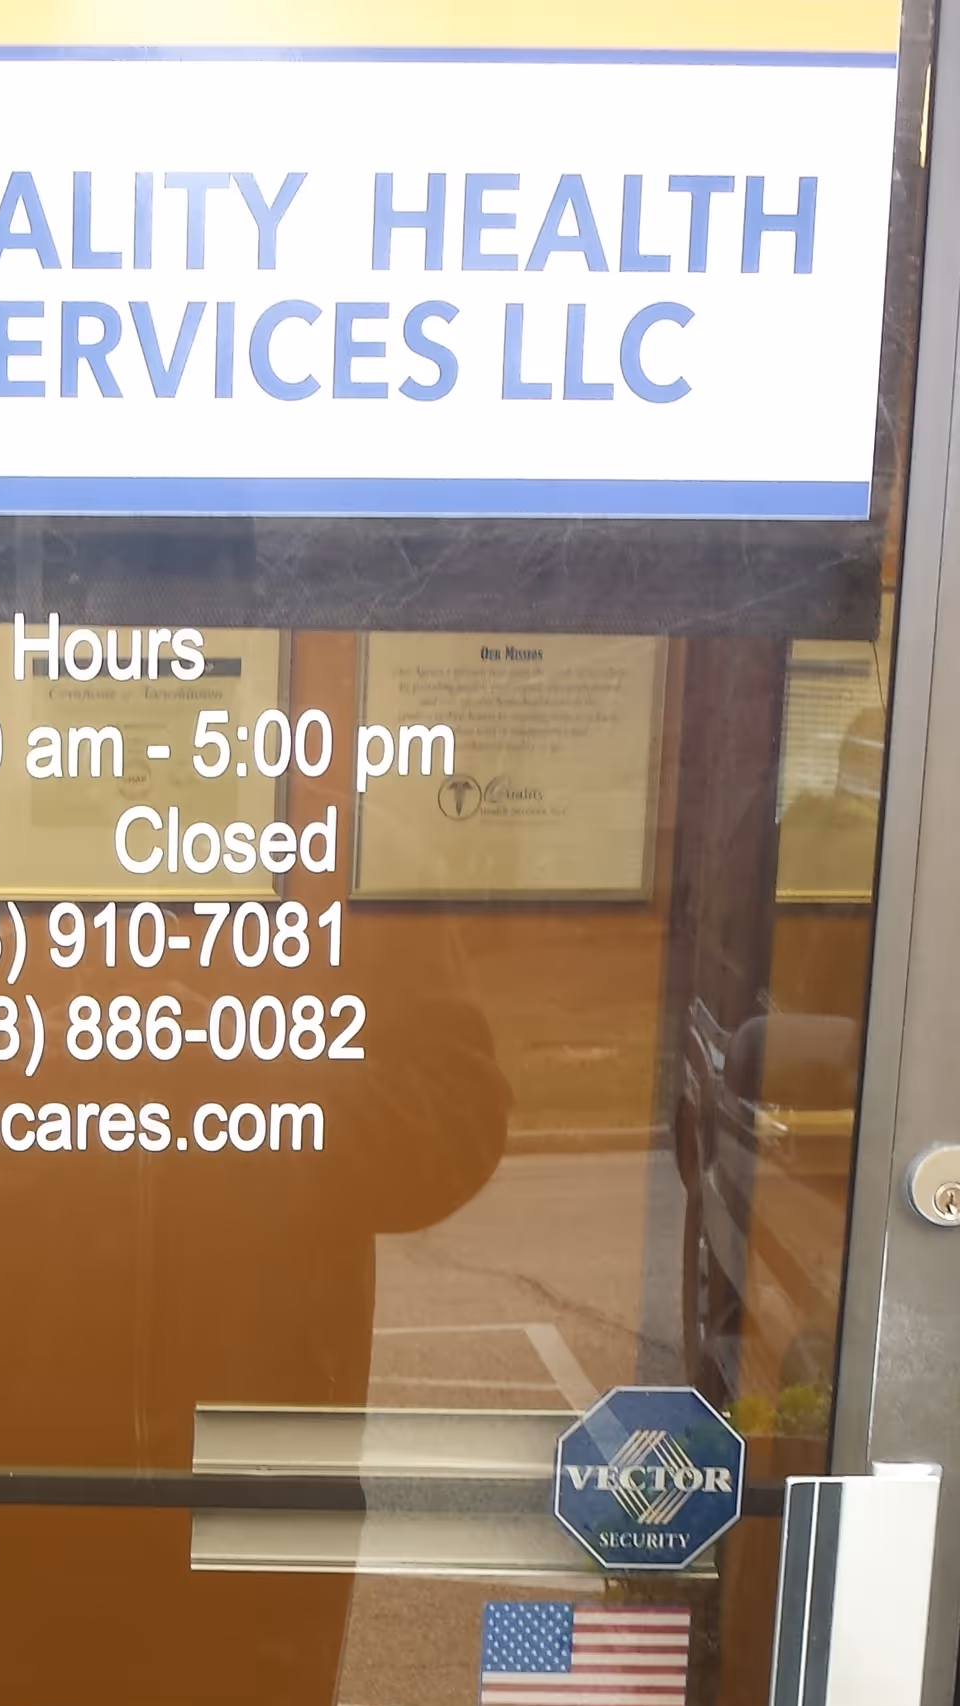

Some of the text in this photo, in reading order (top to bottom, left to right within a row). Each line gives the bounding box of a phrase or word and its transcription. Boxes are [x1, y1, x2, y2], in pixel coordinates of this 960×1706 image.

[372, 172, 818, 275] HEALTH
[502, 302, 696, 404] LLC
[14, 612, 205, 681] Hours
[26, 726, 123, 779] am
[147, 745, 170, 759] -
[193, 709, 332, 778] 5:00
[356, 724, 455, 793] pm
[115, 805, 337, 874] Closed
[49, 901, 341, 968] 910-7081
[66, 995, 366, 1061] 886-0082
[566, 1465, 733, 1493] VECTOR
[599, 1532, 690, 1550] SECURITY
